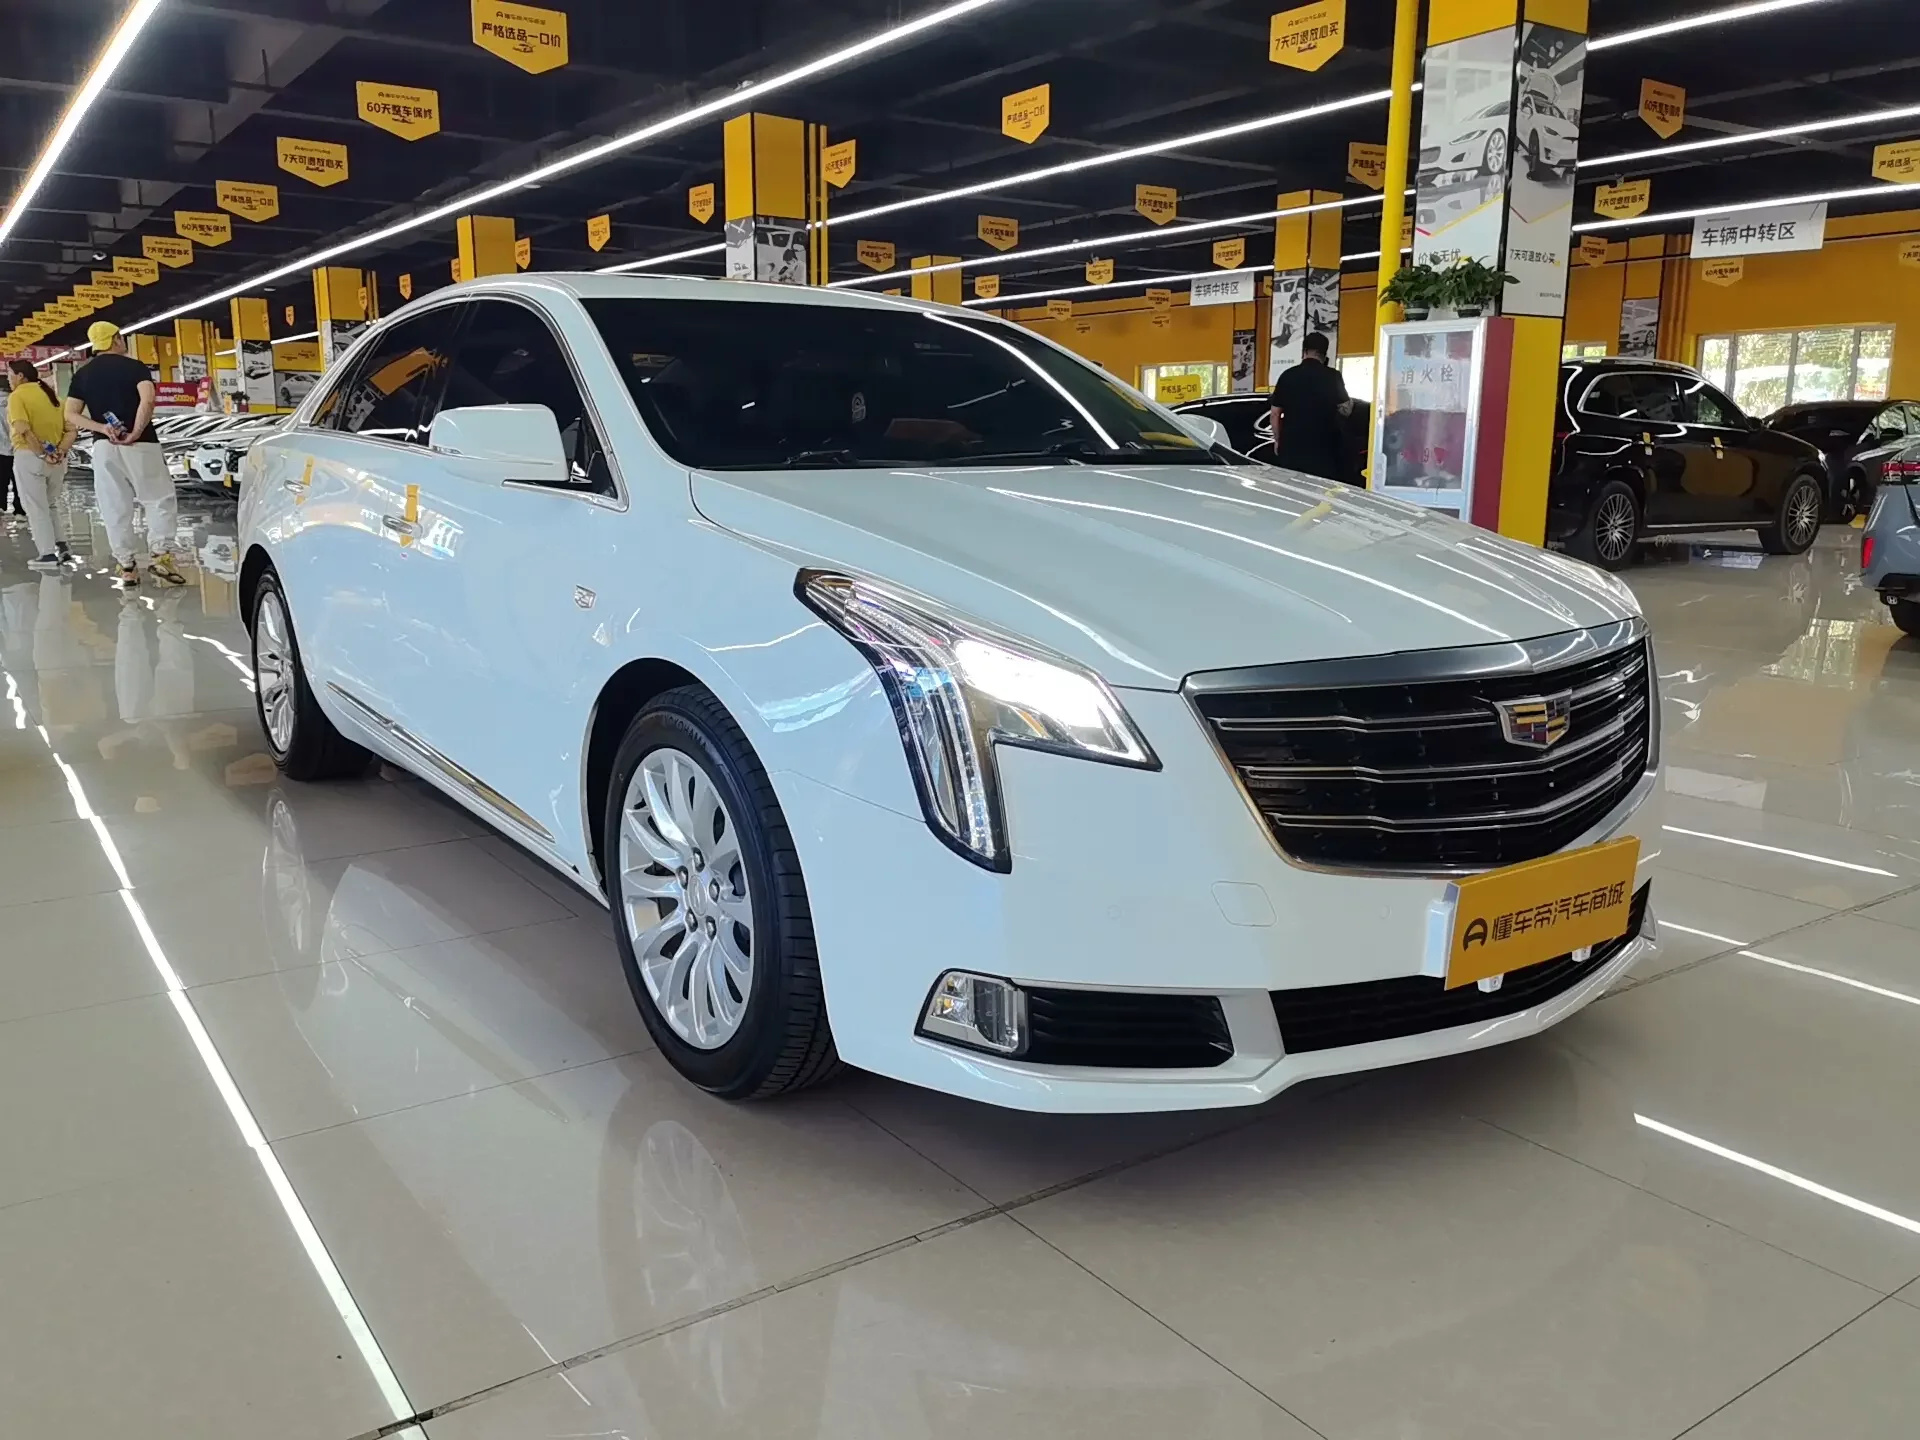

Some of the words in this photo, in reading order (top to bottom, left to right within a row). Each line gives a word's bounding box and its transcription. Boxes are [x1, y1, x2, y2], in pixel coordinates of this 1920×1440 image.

[481, 22, 561, 48] 严格选品一口价
[1275, 22, 1339, 51] 7天可退放心买
[366, 102, 433, 120] 60天整车保修
[282, 153, 344, 170] 7天可退放心买
[1701, 221, 1797, 247] 车辆中转区
[1509, 247, 1556, 265] 7天可退放心买
[1194, 280, 1240, 297] 车辆中转区
[1401, 364, 1454, 384] 消火栓
[1491, 880, 1626, 941] 懂车帝汽车商城
